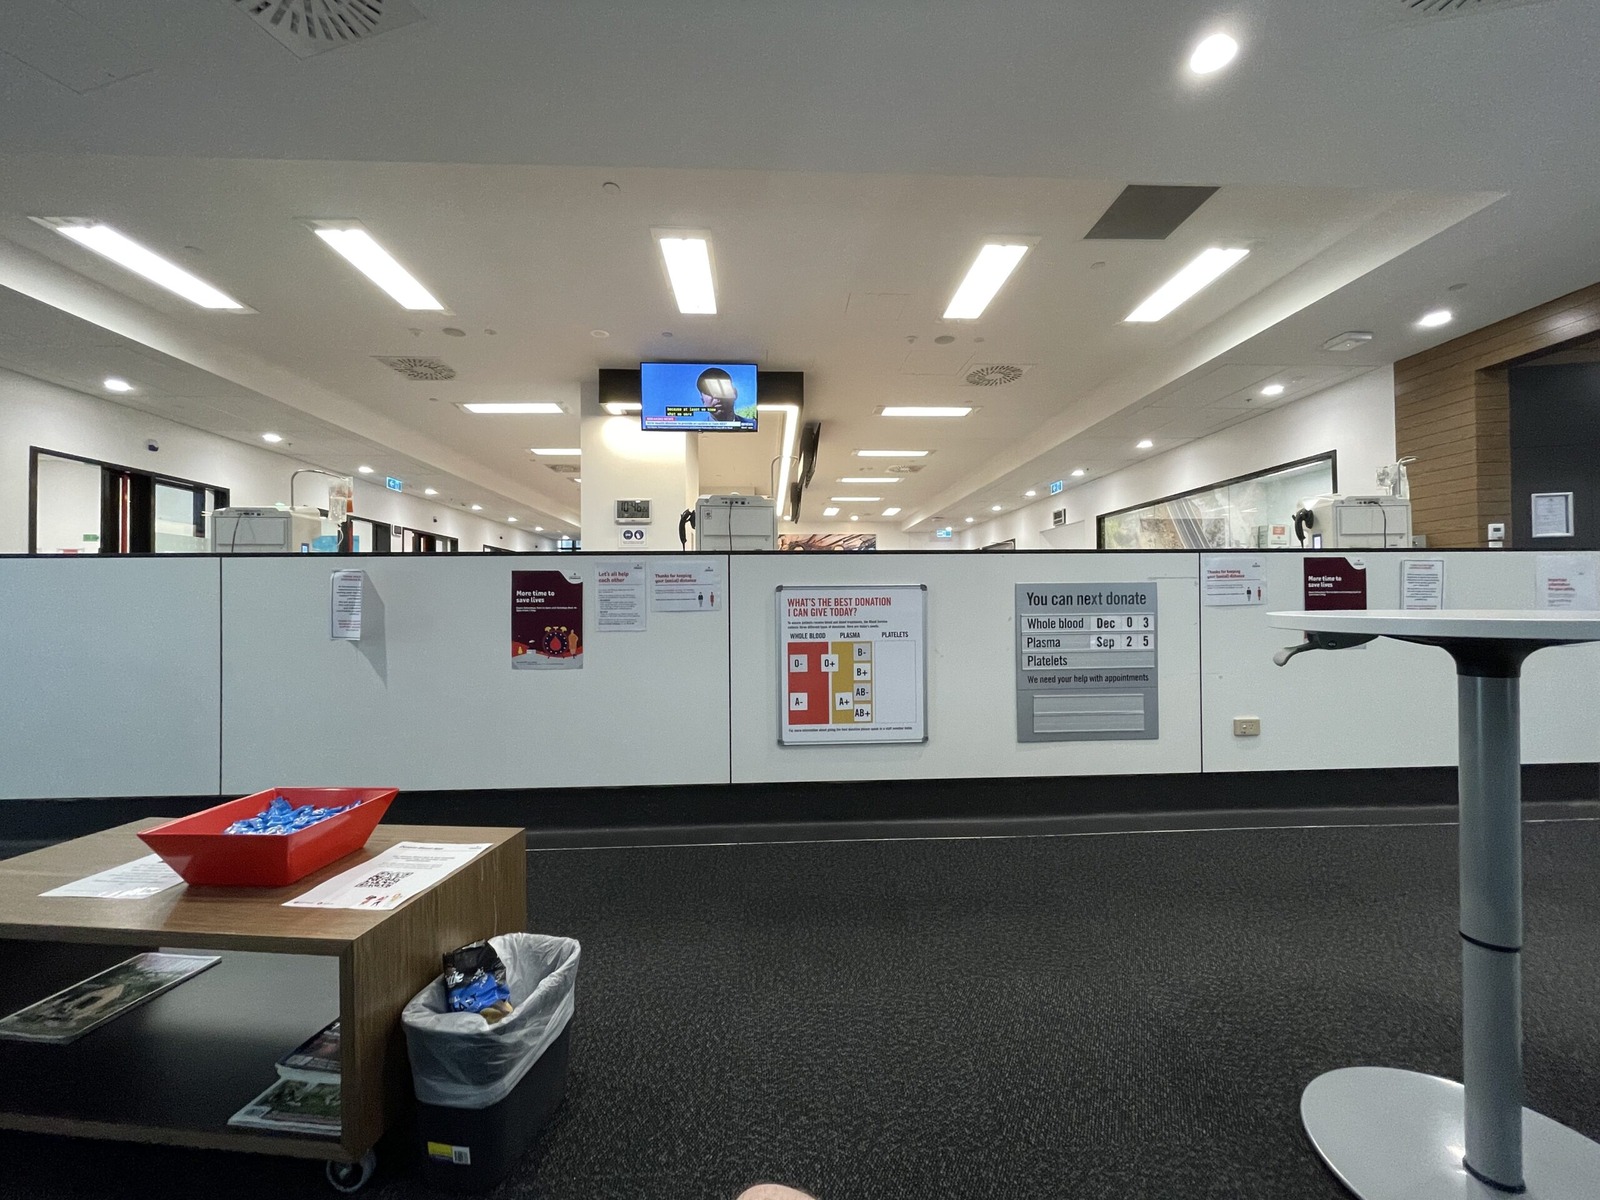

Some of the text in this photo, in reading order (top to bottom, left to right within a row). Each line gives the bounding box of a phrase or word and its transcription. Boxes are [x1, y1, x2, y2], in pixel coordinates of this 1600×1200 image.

[788, 597, 892, 608] WHAT'S THE BEST DONATION
[1027, 591, 1146, 606] You can next donate
[793, 608, 808, 617] CAN
[810, 608, 827, 617] GIVE
[830, 607, 857, 617] TODAY?
[1027, 617, 1149, 629] Whole blood Dec 0 3
[1027, 636, 1149, 649] Plasma Sep 2 5
[857, 648, 866, 656] B-
[1027, 655, 1068, 666] Platelets
[856, 668, 868, 676] B+
[1027, 674, 1149, 684] We need your help with appointments
[855, 688, 869, 696] AB-
[794, 698, 803, 706] A-
[839, 697, 850, 706] A+
[854, 708, 870, 717] AB+
